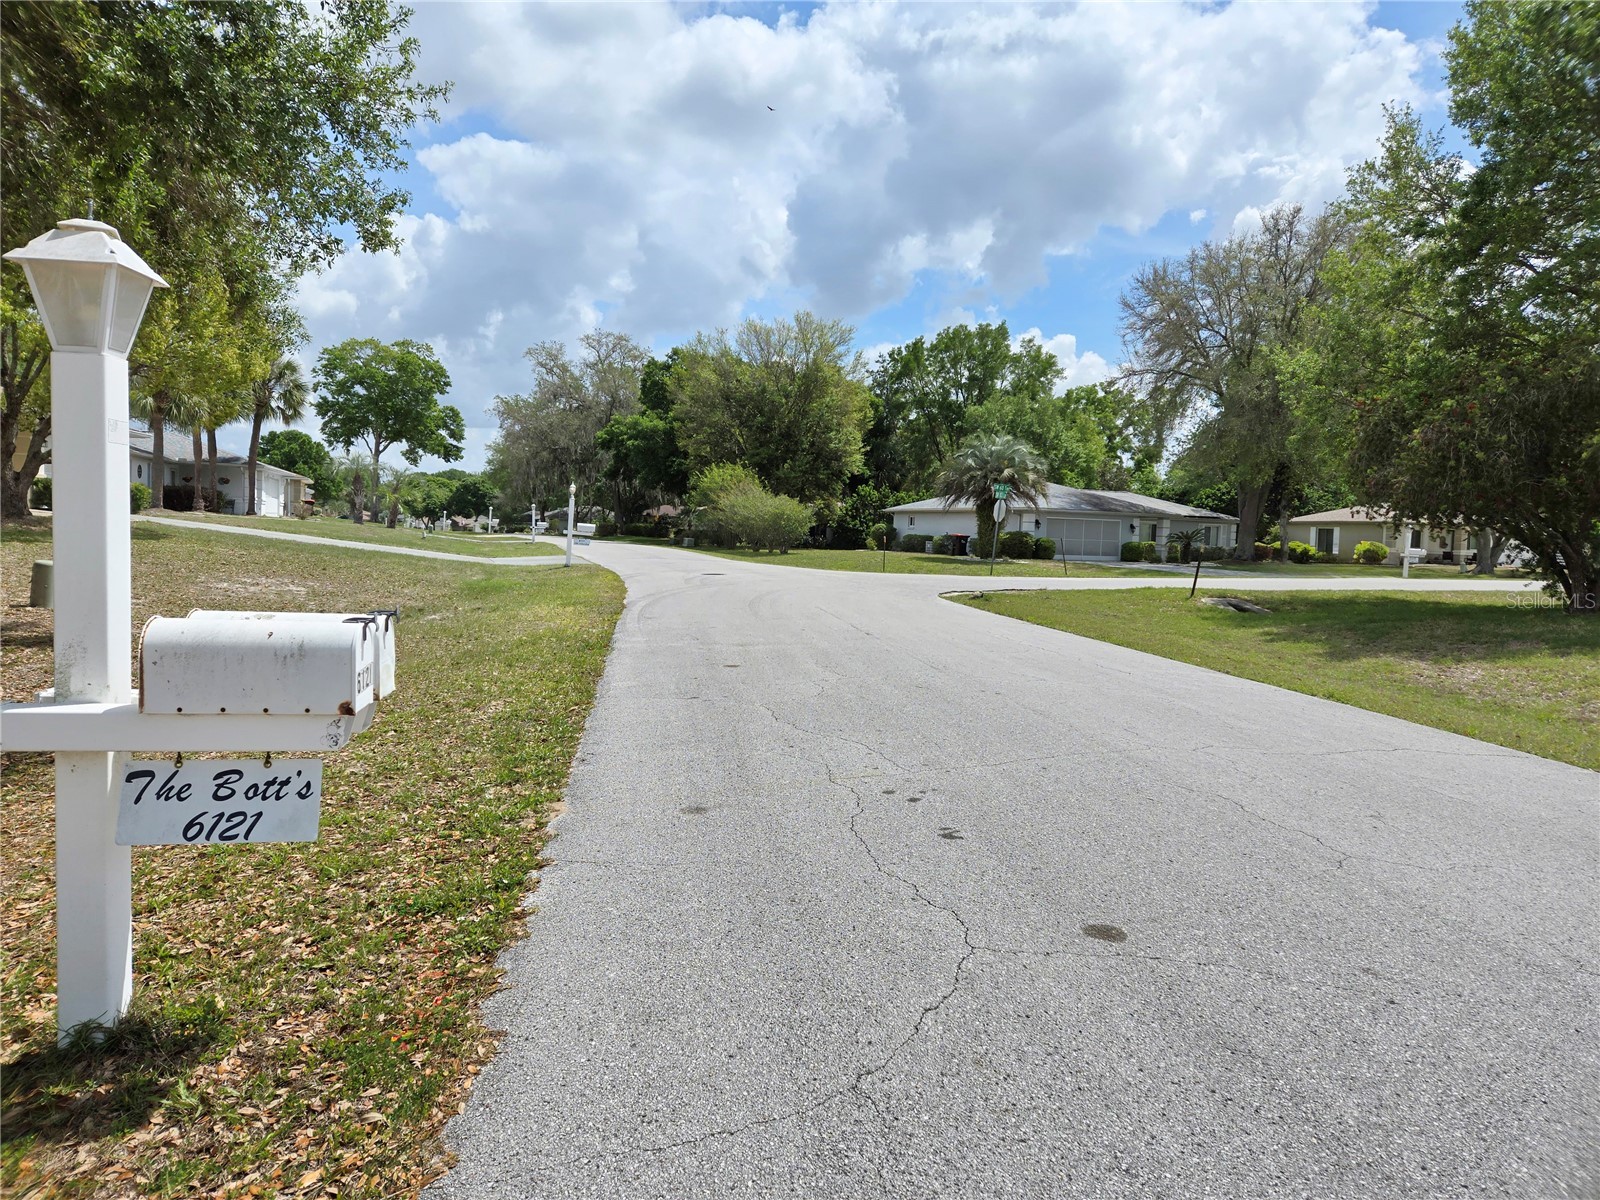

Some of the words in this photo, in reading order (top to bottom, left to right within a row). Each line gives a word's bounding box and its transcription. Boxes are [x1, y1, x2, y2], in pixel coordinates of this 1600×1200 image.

[357, 663, 372, 694] 6121
[125, 769, 193, 805] The
[211, 769, 314, 802] Bott's
[182, 810, 264, 842] 6121
